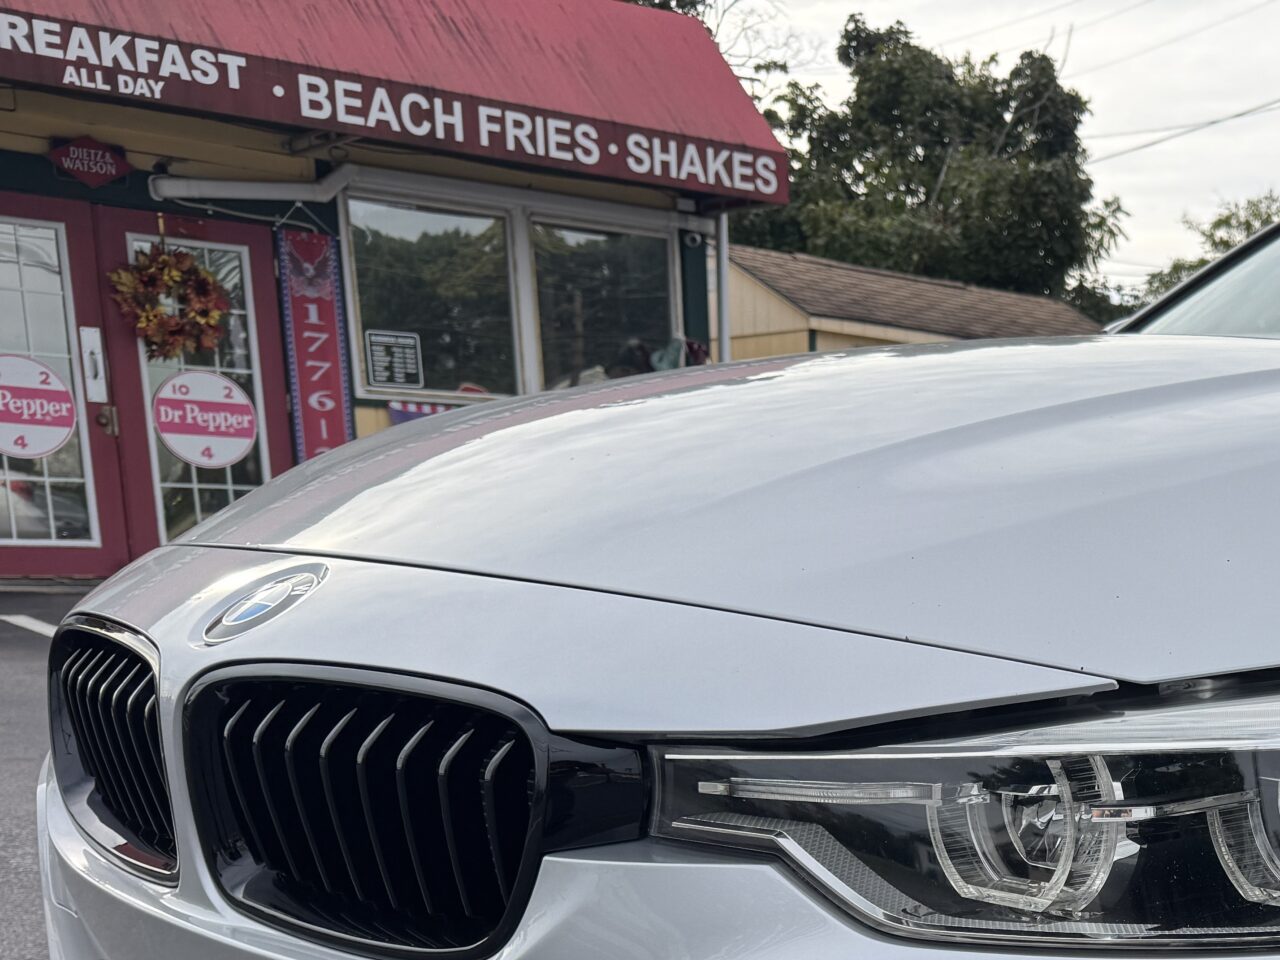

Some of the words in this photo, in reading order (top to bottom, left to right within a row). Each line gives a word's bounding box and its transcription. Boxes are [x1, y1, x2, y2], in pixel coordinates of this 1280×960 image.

[0, 12, 247, 90] REAKFAST
[62, 65, 111, 91] ALL
[117, 74, 165, 99] DAY
[298, 73, 464, 142] BEACH
[478, 105, 600, 165] FRIES
[626, 133, 778, 195] SHAKES
[69, 147, 103, 162] DIETZ
[61, 157, 116, 175] WATSON
[39, 371, 51, 385] 2
[171, 383, 190, 396] 10
[223, 386, 234, 399] 2
[0, 390, 71, 420] Pepper
[159, 405, 183, 423] Dr
[185, 403, 252, 432] Pepper
[13, 435, 28, 449] 4
[201, 446, 213, 460] 4
